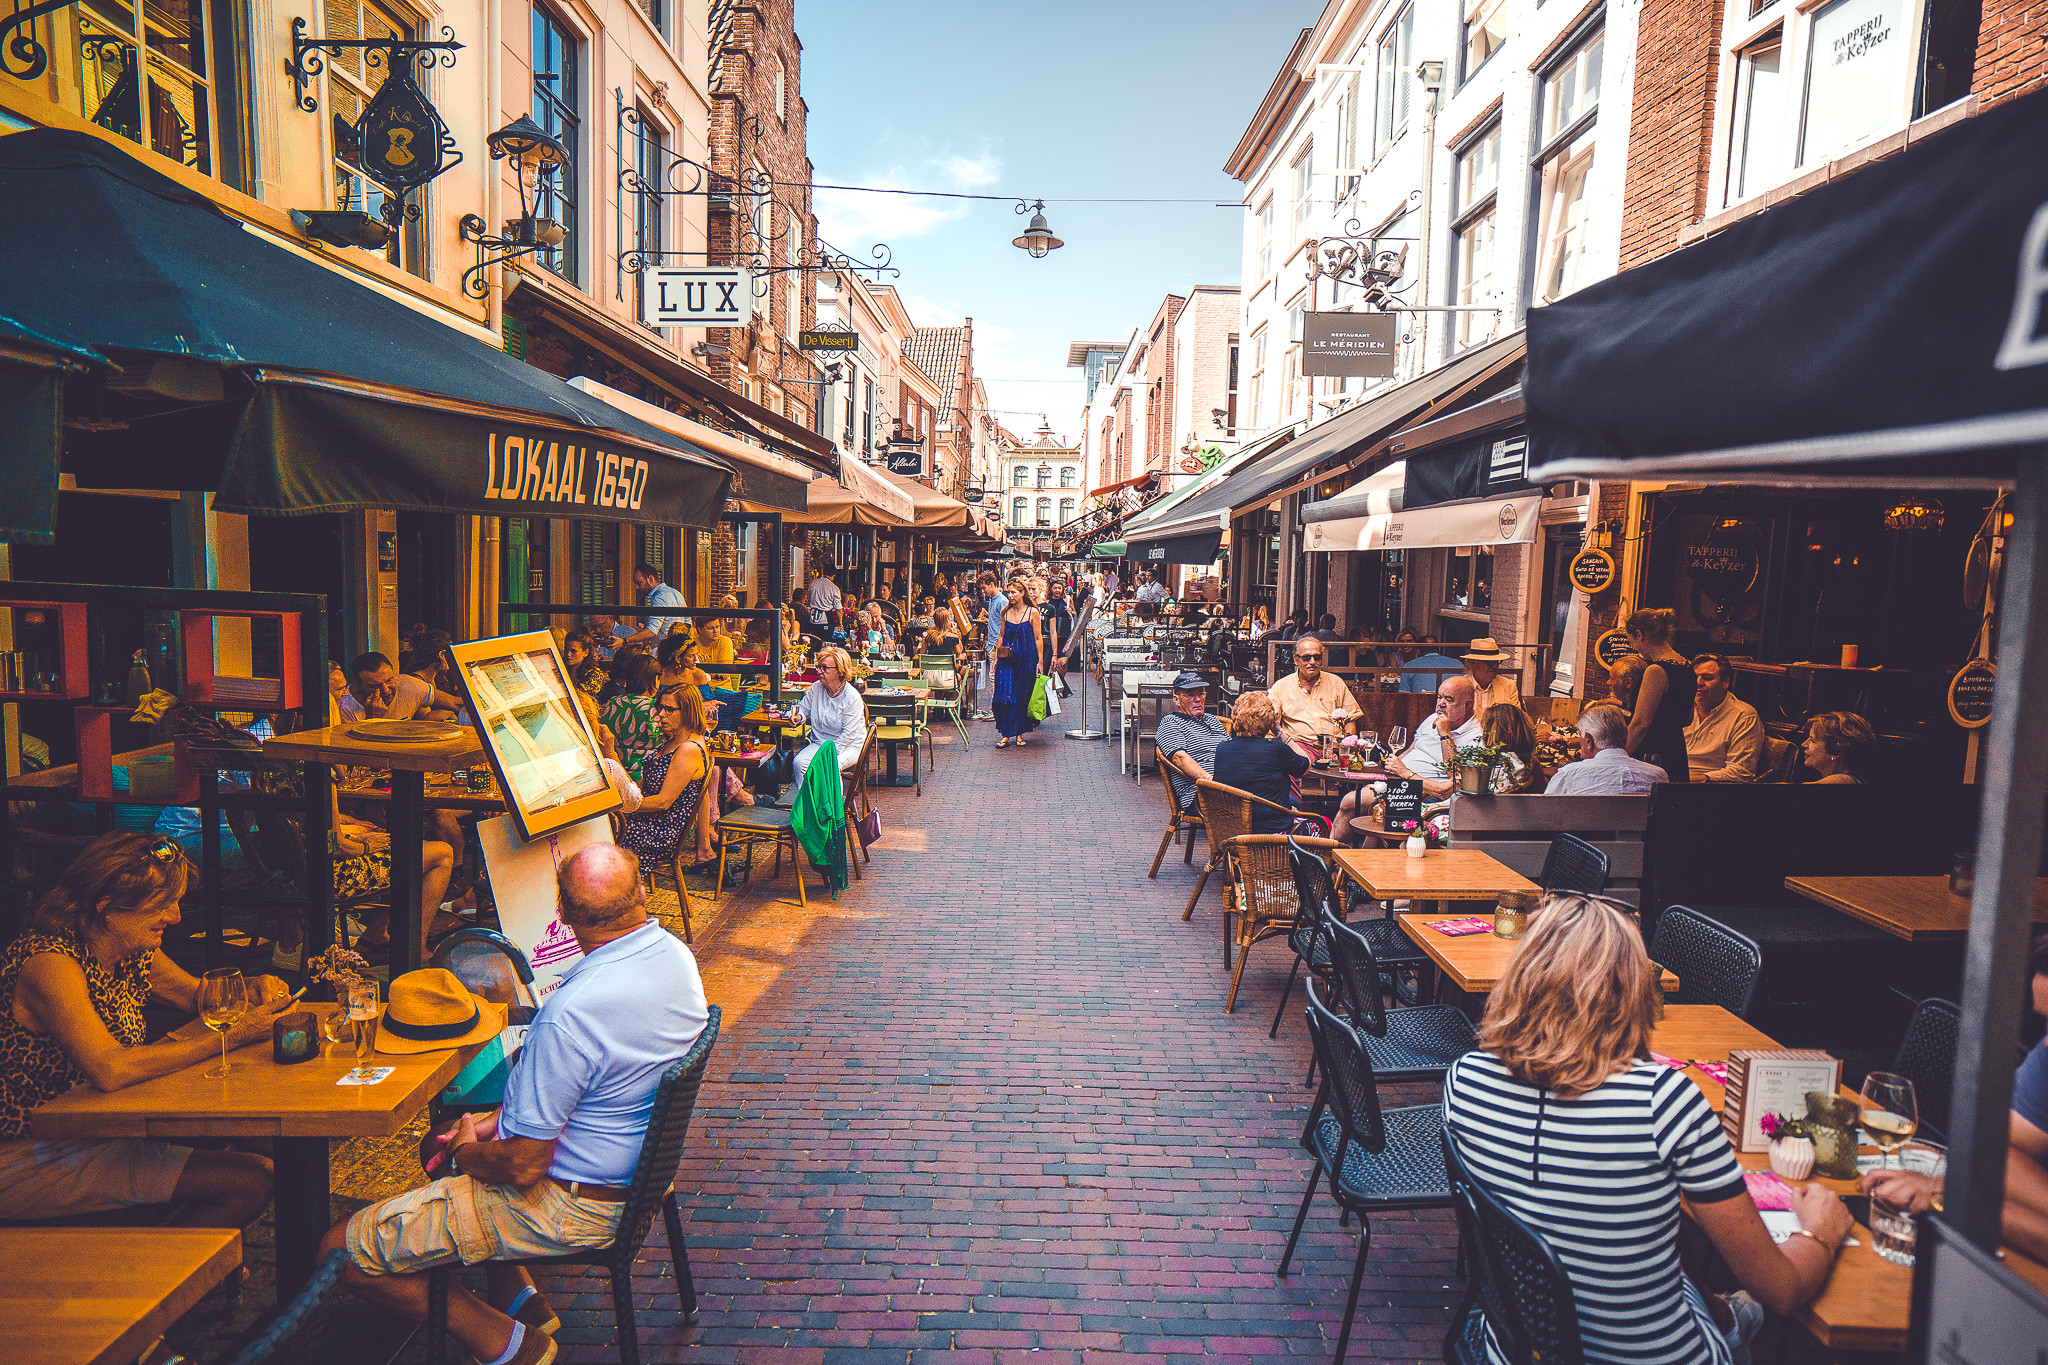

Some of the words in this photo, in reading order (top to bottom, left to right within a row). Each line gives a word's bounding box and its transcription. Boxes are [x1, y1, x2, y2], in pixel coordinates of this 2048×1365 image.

[1833, 13, 1883, 52] TAPPERIJ
[1846, 27, 1891, 61] Keyzer
[658, 281, 739, 313] LUX
[804, 335, 817, 346] De
[817, 334, 854, 349] Visserij
[1313, 340, 1327, 348] LE
[1330, 338, 1385, 348] MÉRIDIEN
[484, 432, 587, 504] LOKAAL
[593, 450, 649, 510] 1650
[1688, 546, 1738, 558] TAPPERIJ
[1703, 558, 1747, 574] Keyzer
